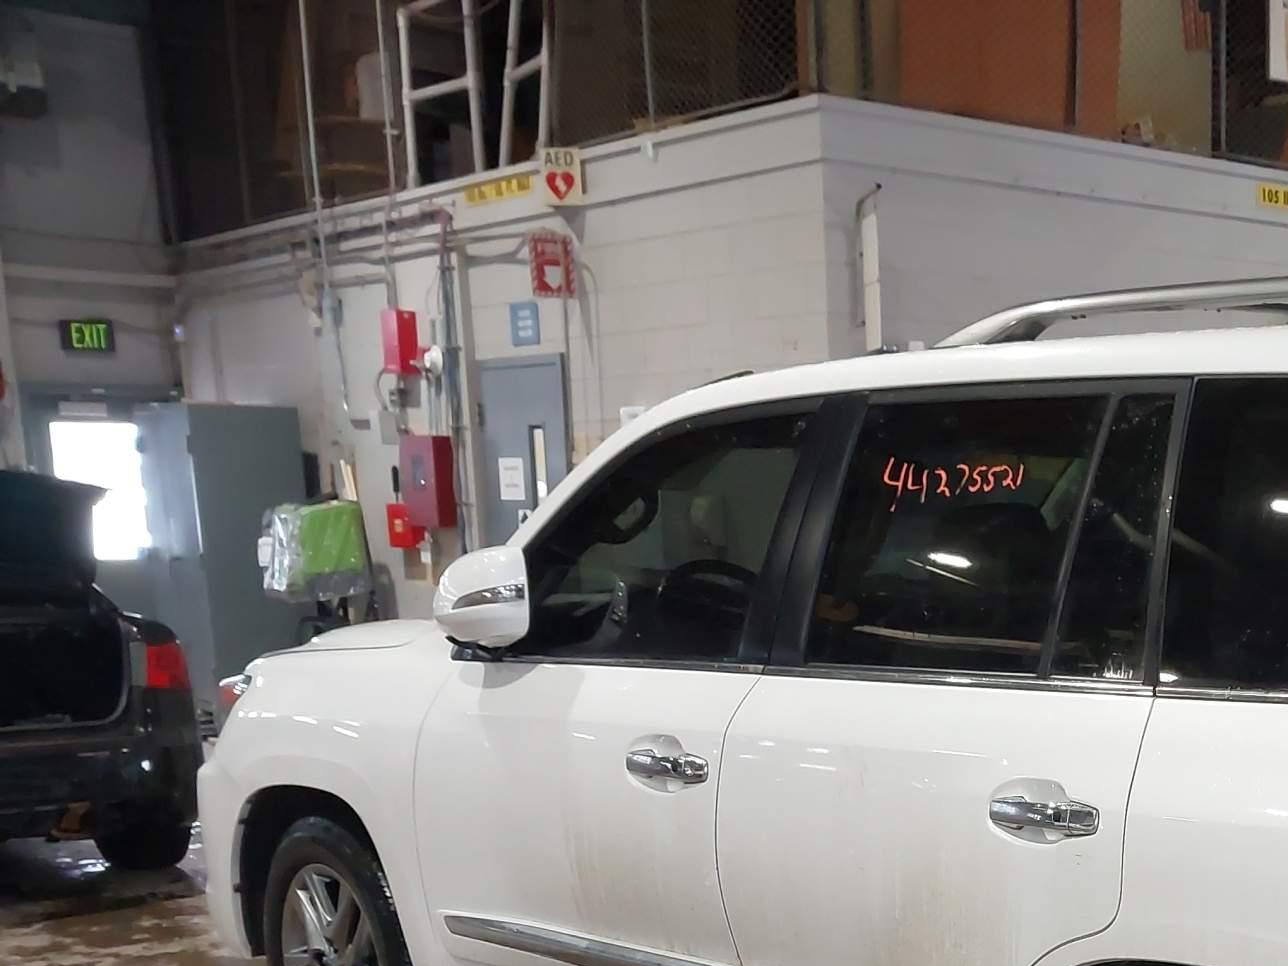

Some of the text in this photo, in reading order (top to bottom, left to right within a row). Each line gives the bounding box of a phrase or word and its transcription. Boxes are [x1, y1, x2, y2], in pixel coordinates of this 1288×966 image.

[544, 151, 574, 167] AED
[1262, 187, 1280, 204] 105
[70, 322, 108, 349] EXIT
[883, 457, 1025, 513] 44275521
